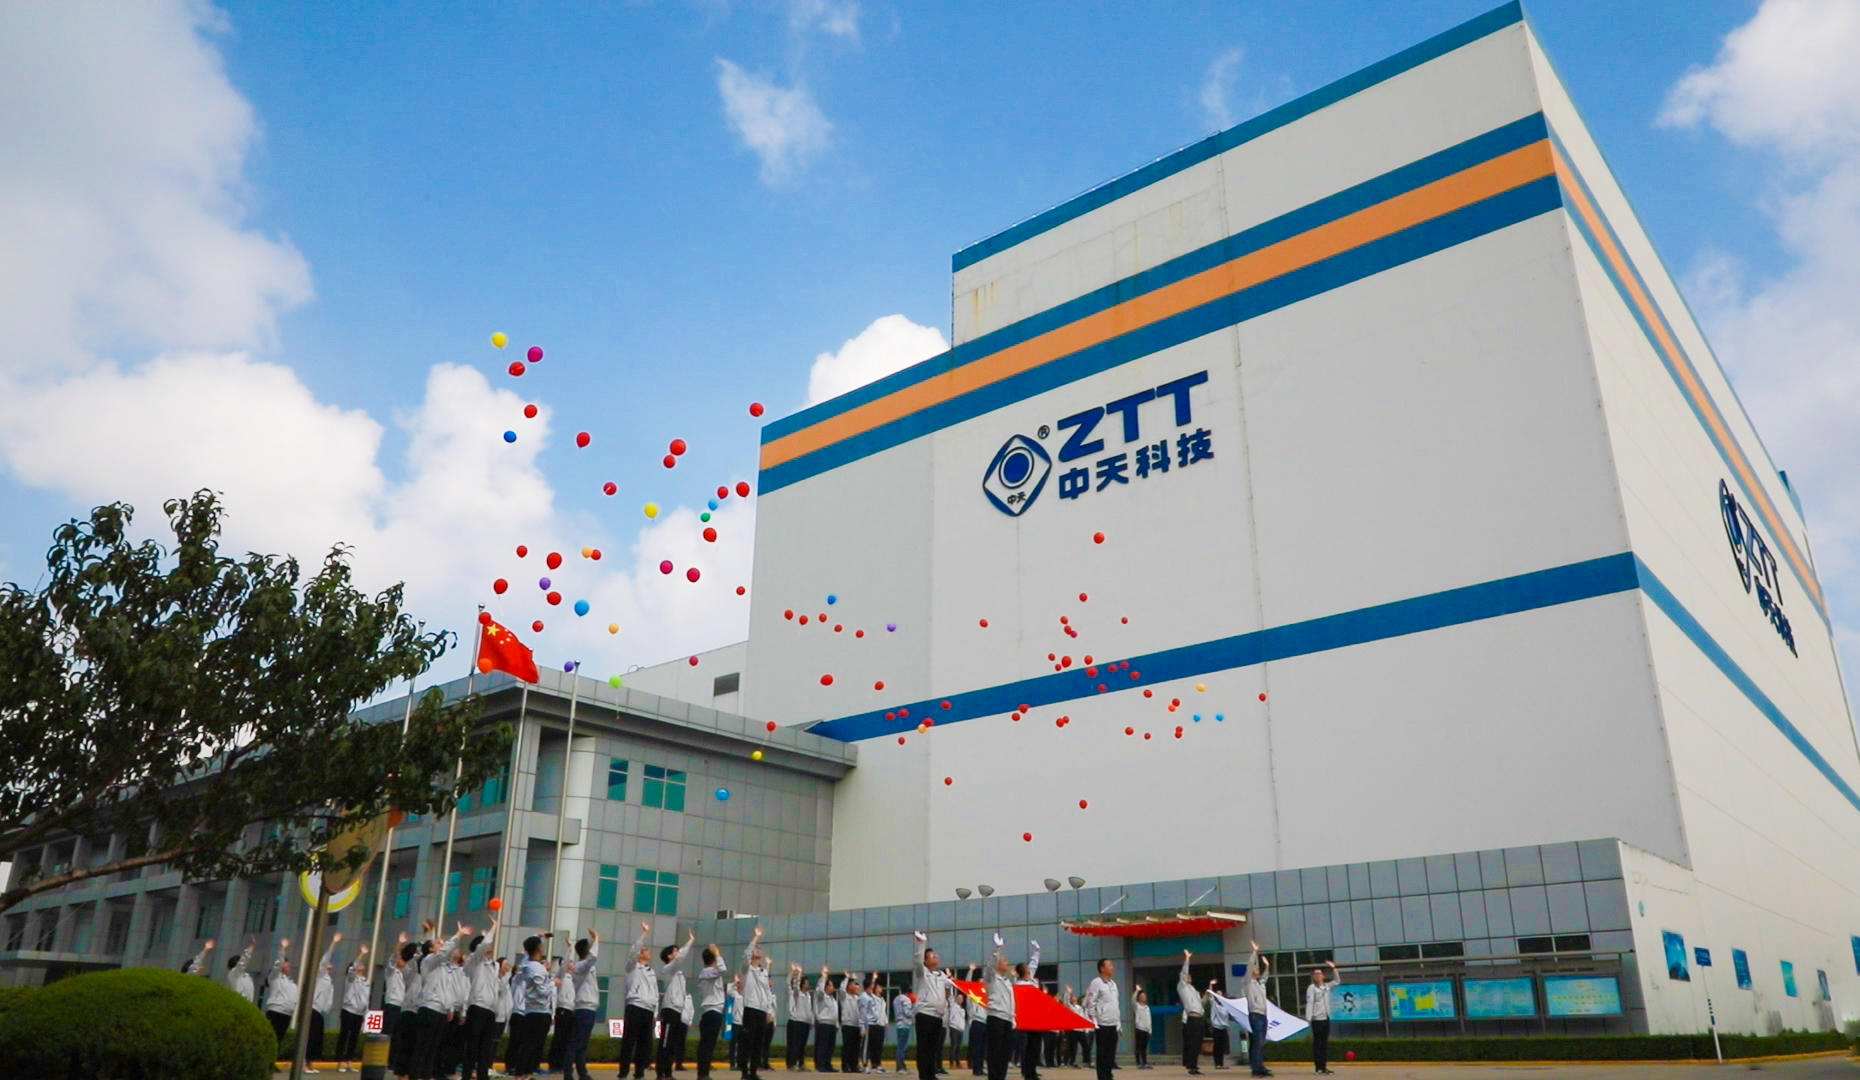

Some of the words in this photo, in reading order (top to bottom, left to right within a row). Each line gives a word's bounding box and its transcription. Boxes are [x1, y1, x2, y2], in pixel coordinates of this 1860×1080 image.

[1057, 370, 1209, 463] ZTT
[1058, 428, 1214, 500] 中天科技
[1007, 491, 1026, 505] 中天
[367, 1014, 382, 1030] 祖
